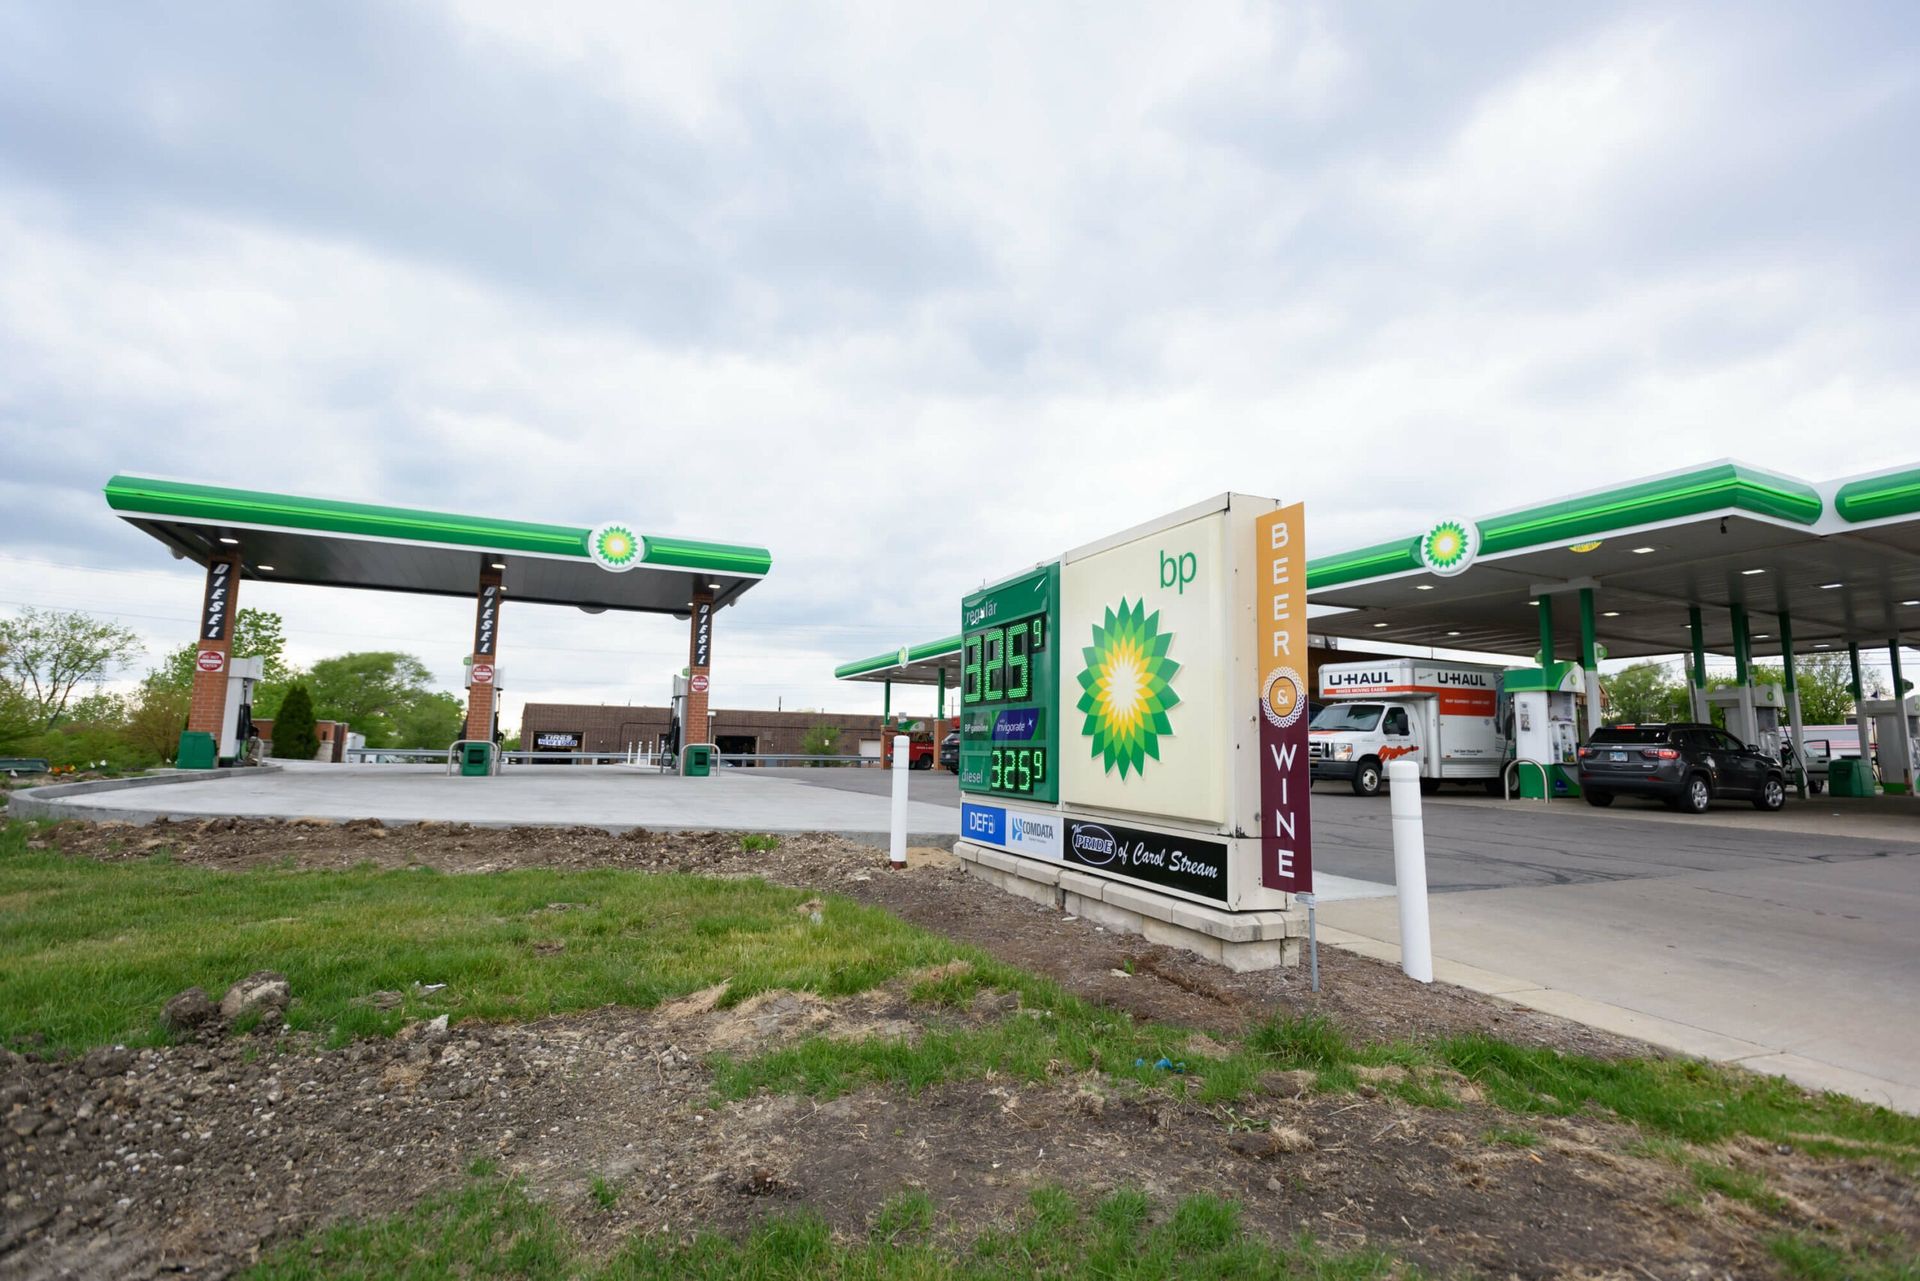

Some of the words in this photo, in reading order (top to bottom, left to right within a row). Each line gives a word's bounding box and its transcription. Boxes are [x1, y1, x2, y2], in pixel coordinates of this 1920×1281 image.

[1160, 550, 1197, 595] bp
[1271, 522, 1290, 657] BEER
[208, 563, 229, 638] DIESEL
[480, 587, 495, 653] DIESEL
[698, 605, 709, 664] DIESEL
[961, 769, 983, 784] diesel
[969, 811, 988, 832] DEF
[1022, 820, 1054, 840] COMDATA
[1071, 824, 1082, 834] The
[1271, 742, 1297, 879] WINE
[1075, 834, 1114, 855] PRIDE
[1117, 841, 1130, 865] of
[1132, 841, 1166, 867] Carol
[1168, 850, 1218, 879] Stream
